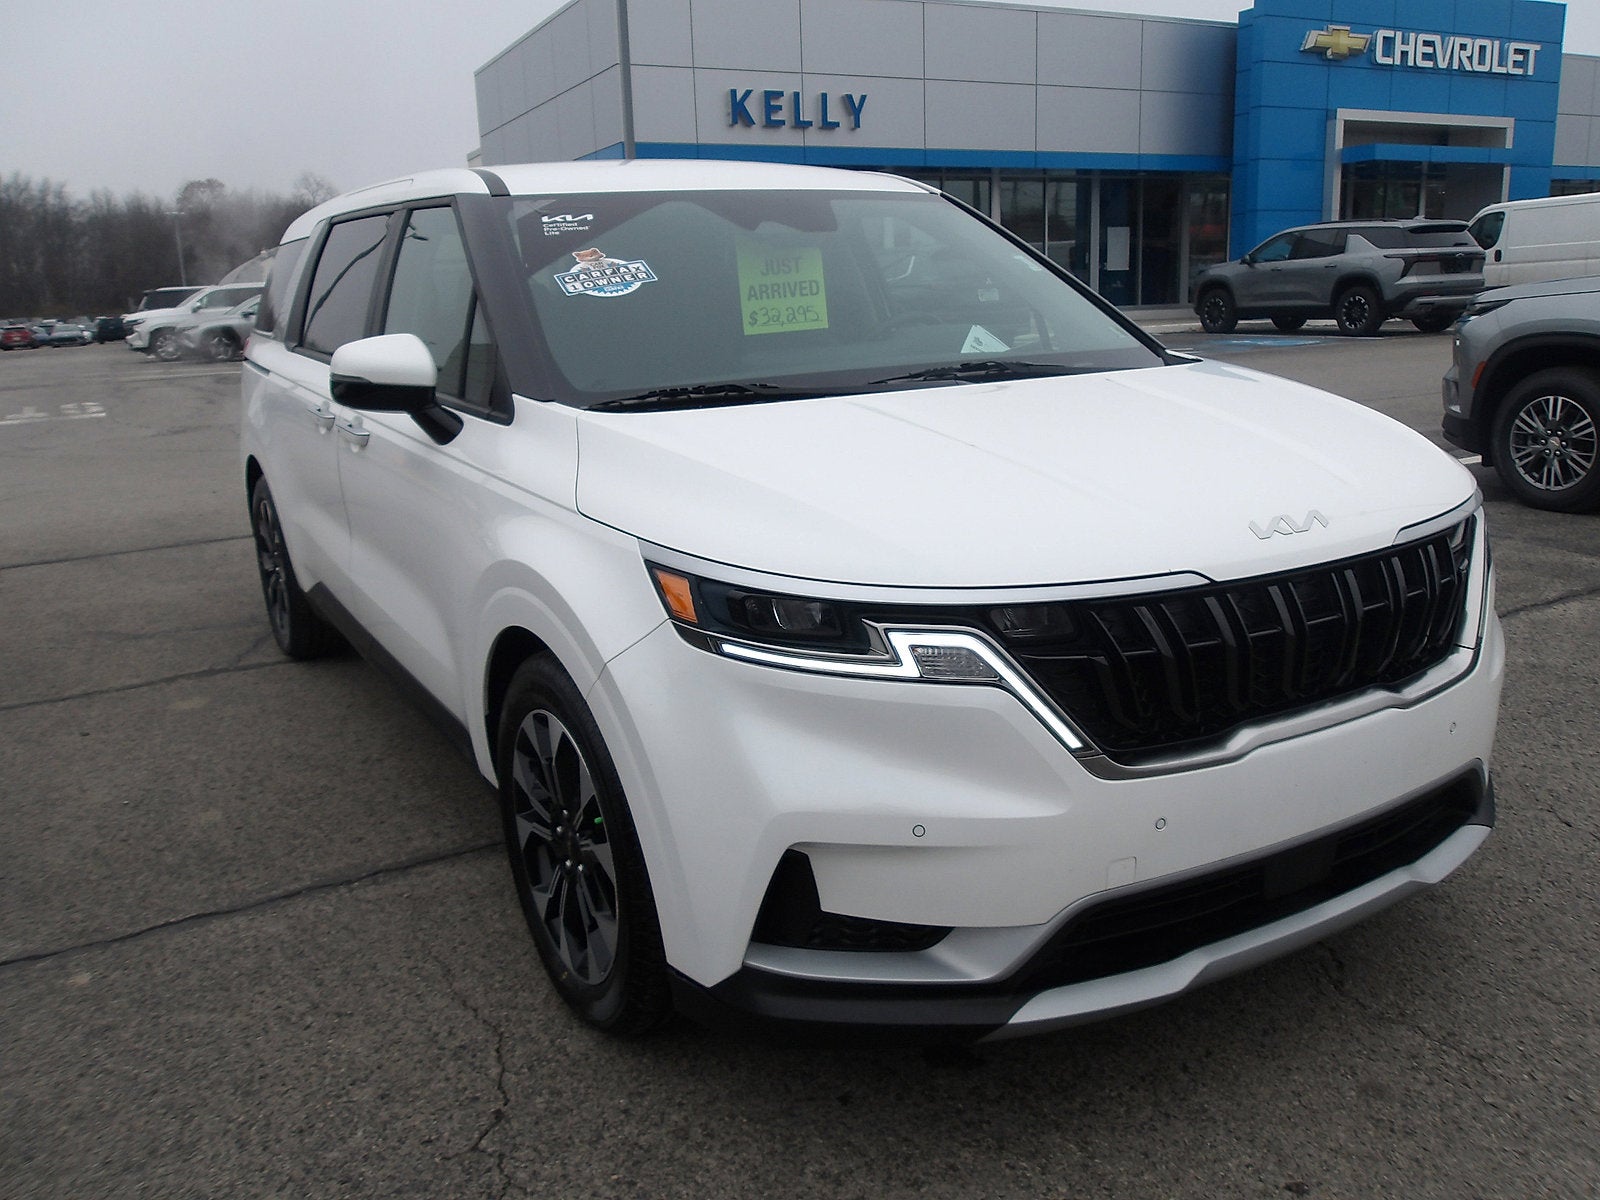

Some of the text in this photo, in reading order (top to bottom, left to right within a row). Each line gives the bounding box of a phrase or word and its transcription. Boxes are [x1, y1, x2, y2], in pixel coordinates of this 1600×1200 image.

[1374, 29, 1542, 76] CHEVROLET
[729, 88, 867, 129] KELLY
[564, 265, 641, 283] CARFAX
[760, 256, 801, 277] JUST
[583, 272, 650, 289] OWNER
[747, 279, 820, 302] ARRIVED
[748, 304, 821, 329] $32,295
